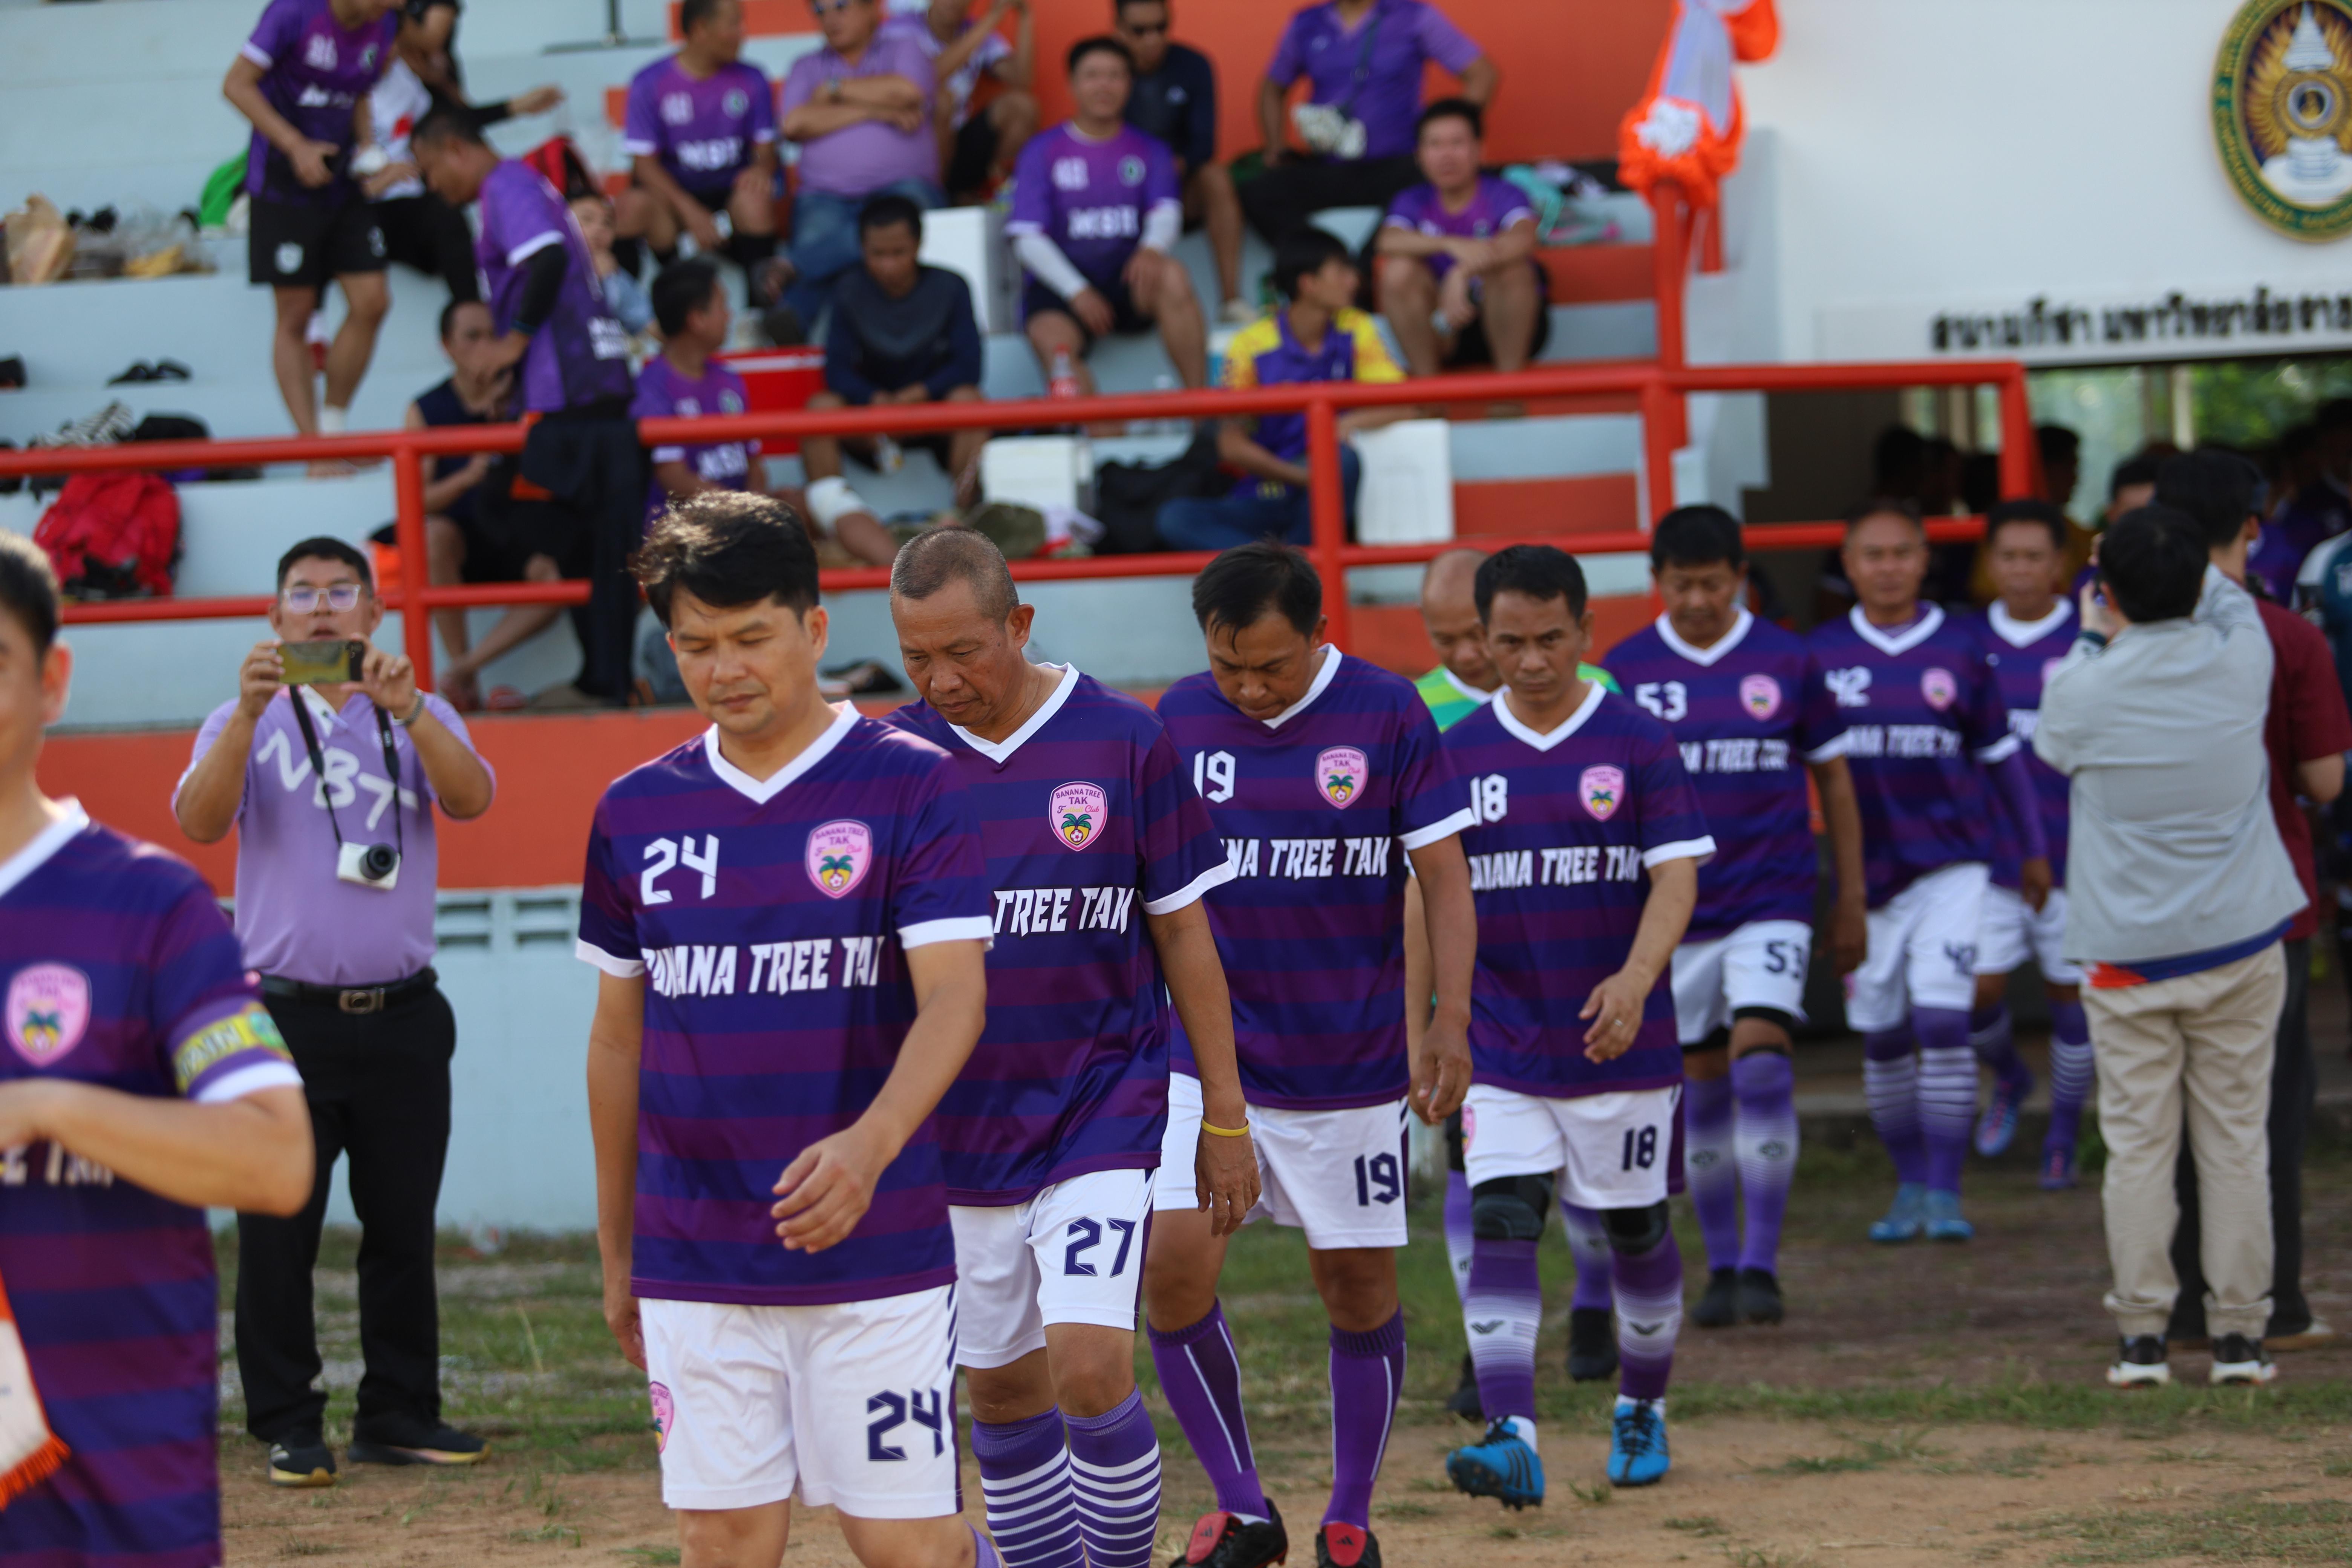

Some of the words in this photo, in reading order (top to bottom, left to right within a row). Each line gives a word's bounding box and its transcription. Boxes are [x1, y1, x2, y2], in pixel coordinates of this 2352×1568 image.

[1634, 680, 1688, 723] 53
[1824, 665, 1873, 708] 42
[1056, 789, 1084, 799] BANANA
[1085, 789, 1101, 798] TREE
[1193, 750, 1236, 804] 19
[1470, 773, 1508, 824] 18
[830, 836, 849, 845] TAK
[1269, 838, 1337, 880] TREE
[1342, 836, 1391, 878] TAK
[640, 833, 720, 905] 24
[1540, 845, 1600, 887] TREE
[994, 888, 1073, 937] TREE
[1078, 887, 1135, 935] TAK
[748, 939, 832, 996] TREE
[1622, 1125, 1657, 1171] 18
[1354, 1152, 1400, 1207] 19
[1064, 1216, 1137, 1278] 27
[867, 1387, 944, 1461] 24
